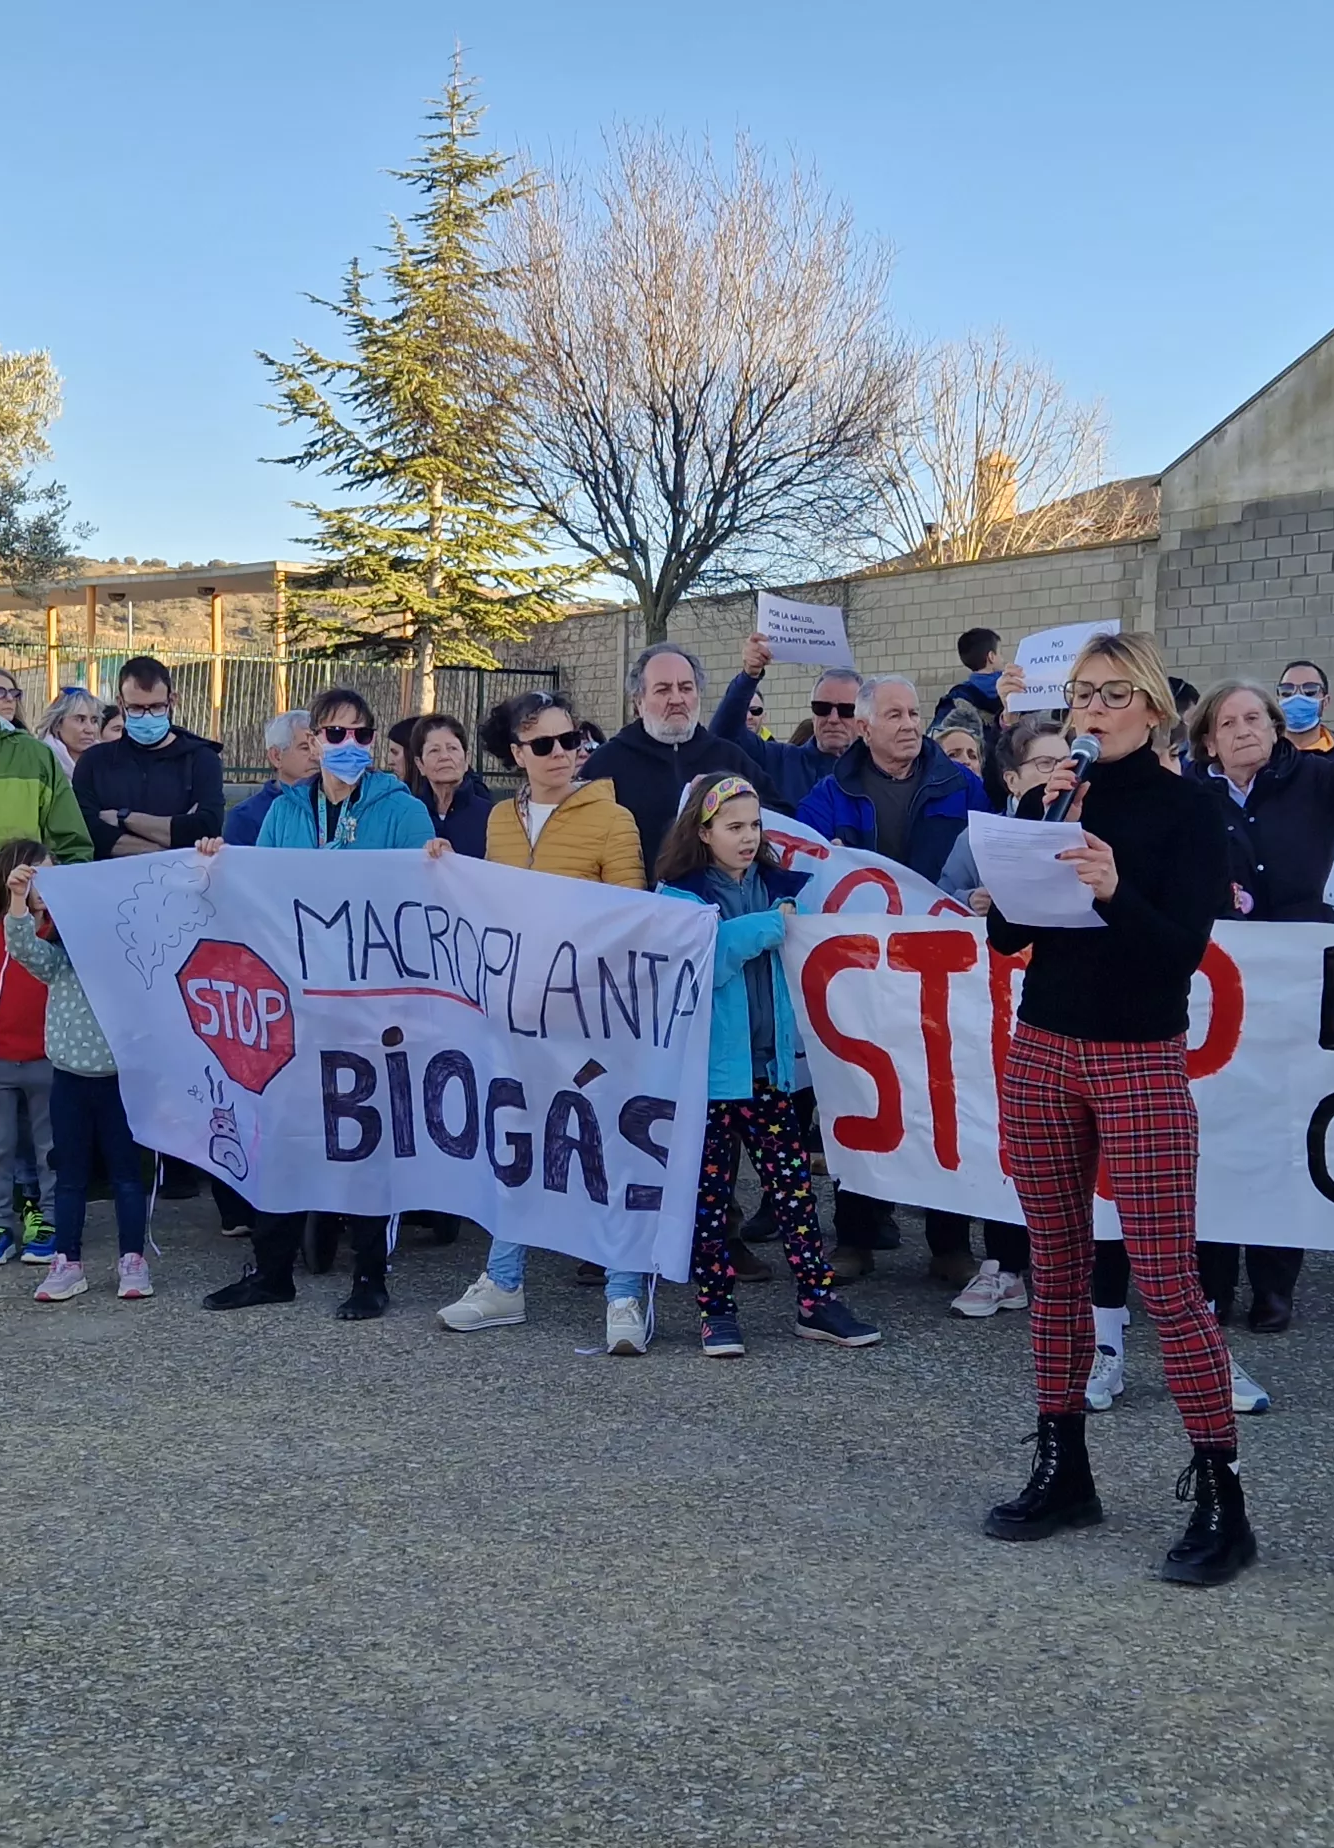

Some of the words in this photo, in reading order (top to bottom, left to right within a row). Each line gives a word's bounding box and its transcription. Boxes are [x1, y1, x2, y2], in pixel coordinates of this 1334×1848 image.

[768, 608, 780, 617] POR
[781, 611, 789, 620] LA
[768, 621, 780, 631] POR
[790, 626, 825, 635] ENTORNO
[779, 636, 807, 645] PLANTA
[808, 638, 836, 647] BIOGAS
[1051, 640, 1064, 649] NO
[1029, 654, 1060, 665] PLANTA
[293, 898, 700, 1049] MACROPLANTA
[186, 978, 286, 1051] STOP
